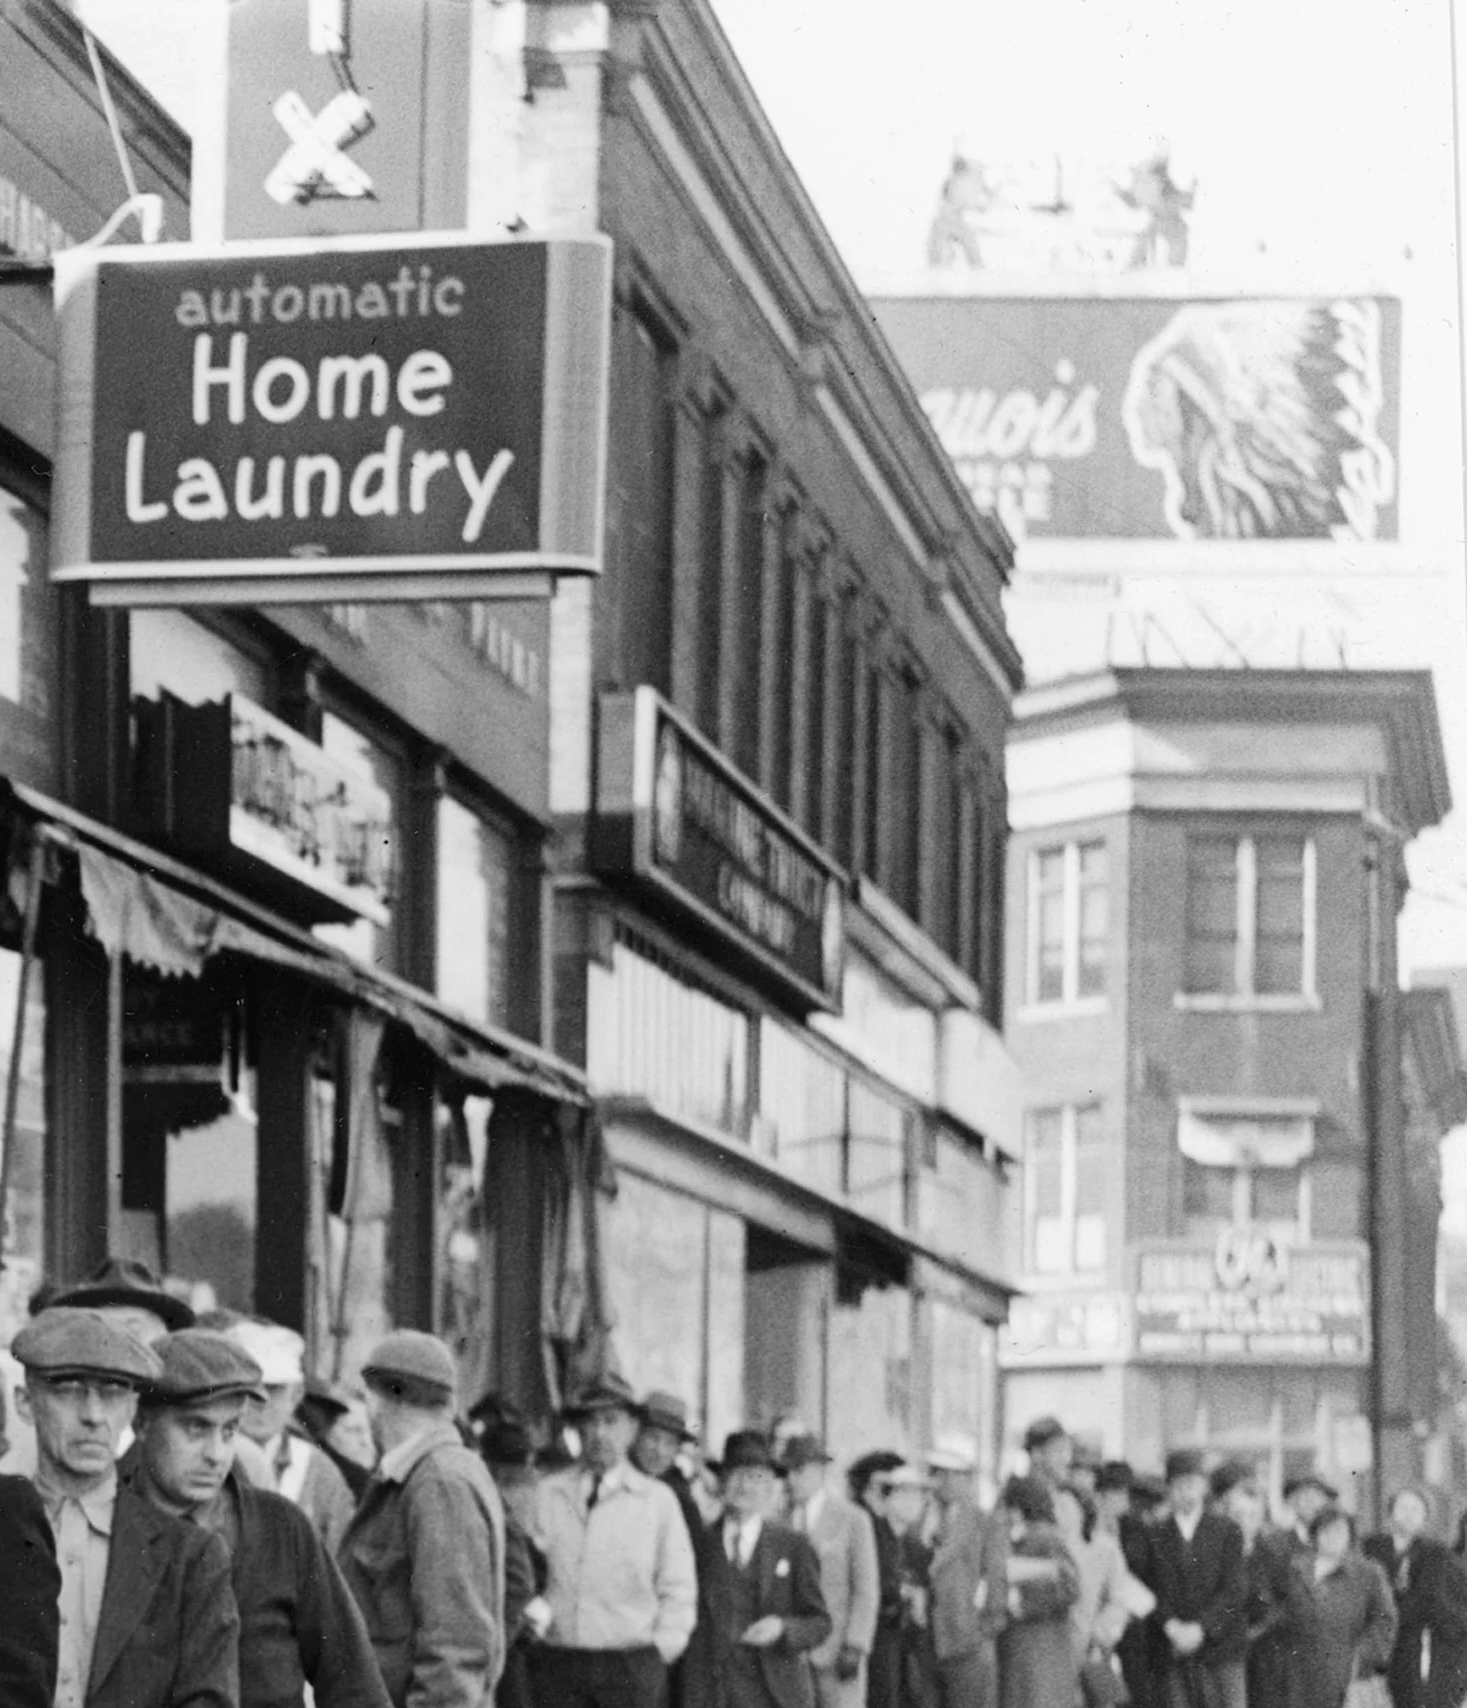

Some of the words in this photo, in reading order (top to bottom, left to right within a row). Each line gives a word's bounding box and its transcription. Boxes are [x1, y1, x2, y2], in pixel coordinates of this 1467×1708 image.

[175, 266, 465, 328] automatic
[192, 332, 453, 426] Home
[124, 425, 514, 543] Laundry
